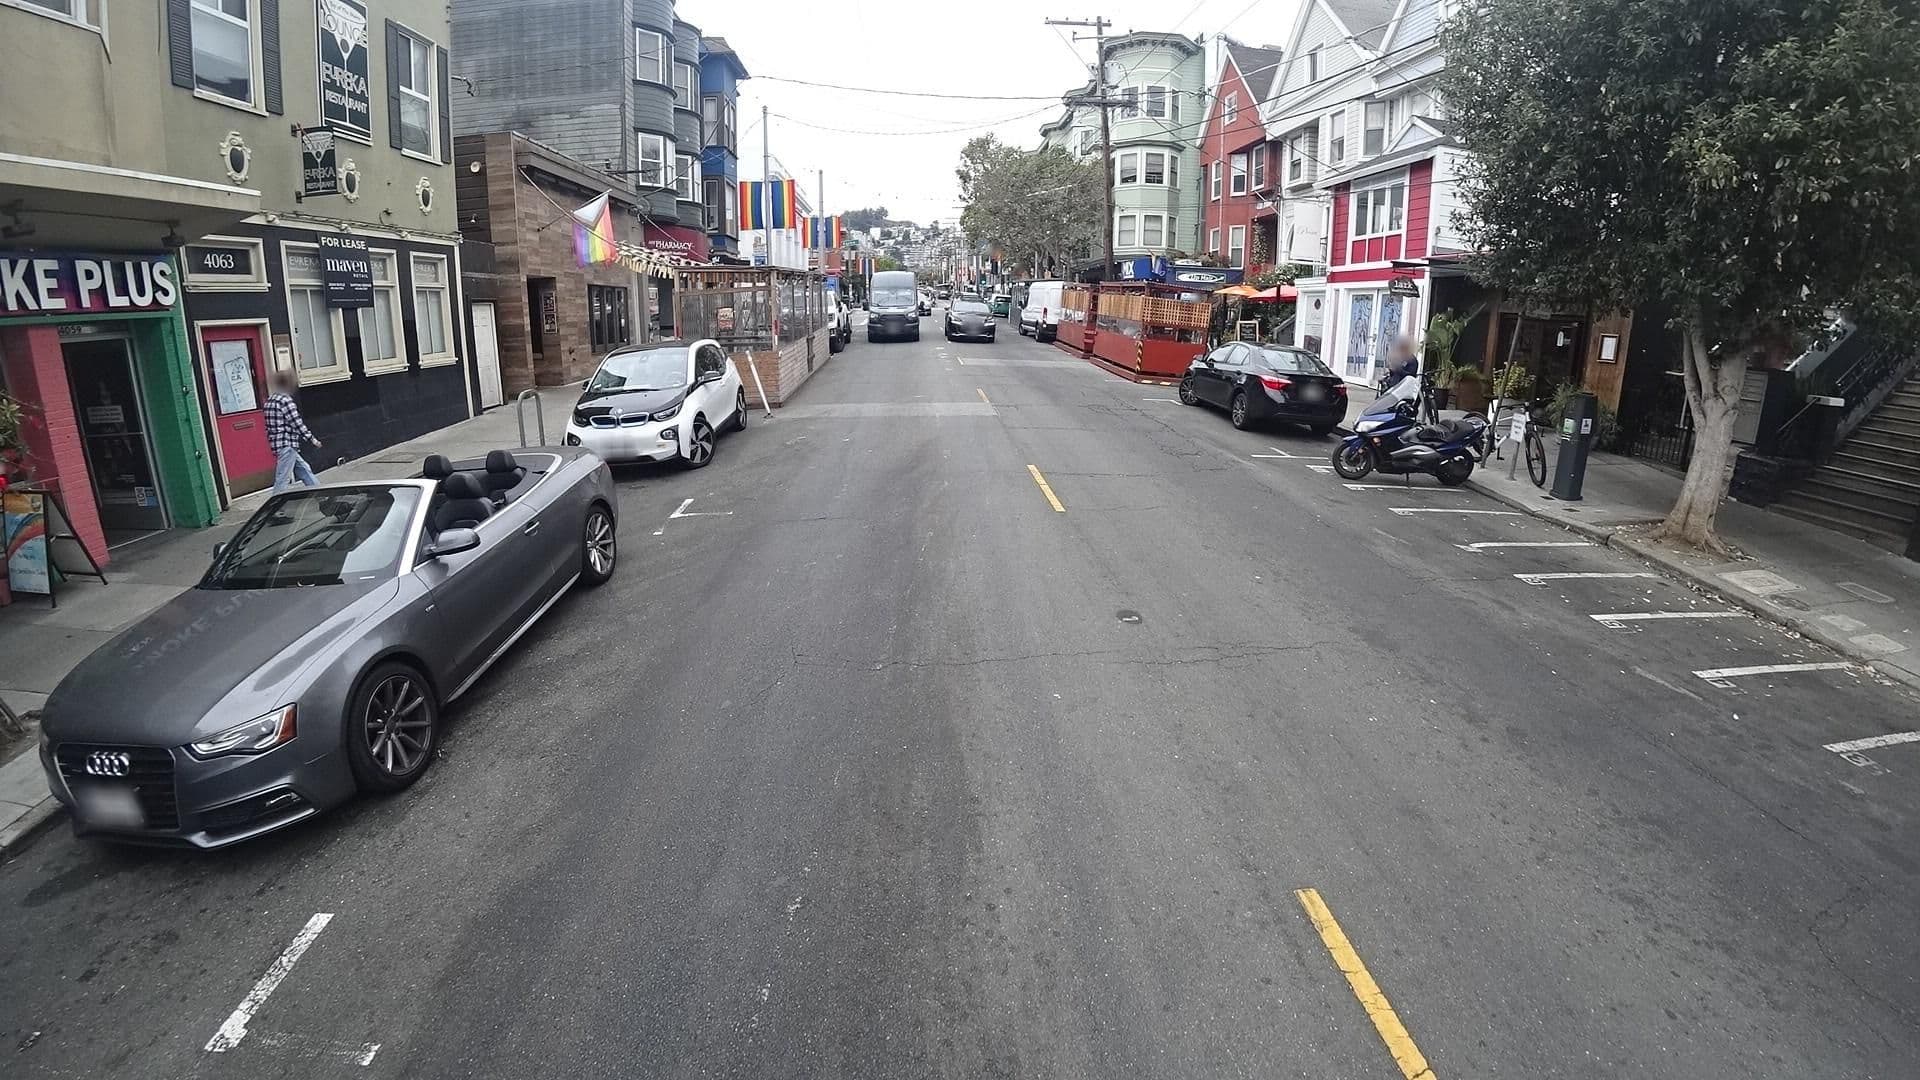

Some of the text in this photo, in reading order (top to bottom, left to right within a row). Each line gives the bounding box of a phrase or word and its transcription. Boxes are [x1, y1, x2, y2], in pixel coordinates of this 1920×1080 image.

[322, 61, 368, 97] EUREKA
[325, 89, 367, 114] RESTAURANT
[321, 236, 366, 250] FOR LEASE
[655, 240, 693, 250] PHARMACY
[203, 253, 235, 269] 4063
[326, 258, 368, 273] maven
[0, 259, 176, 311] KE PLUS
